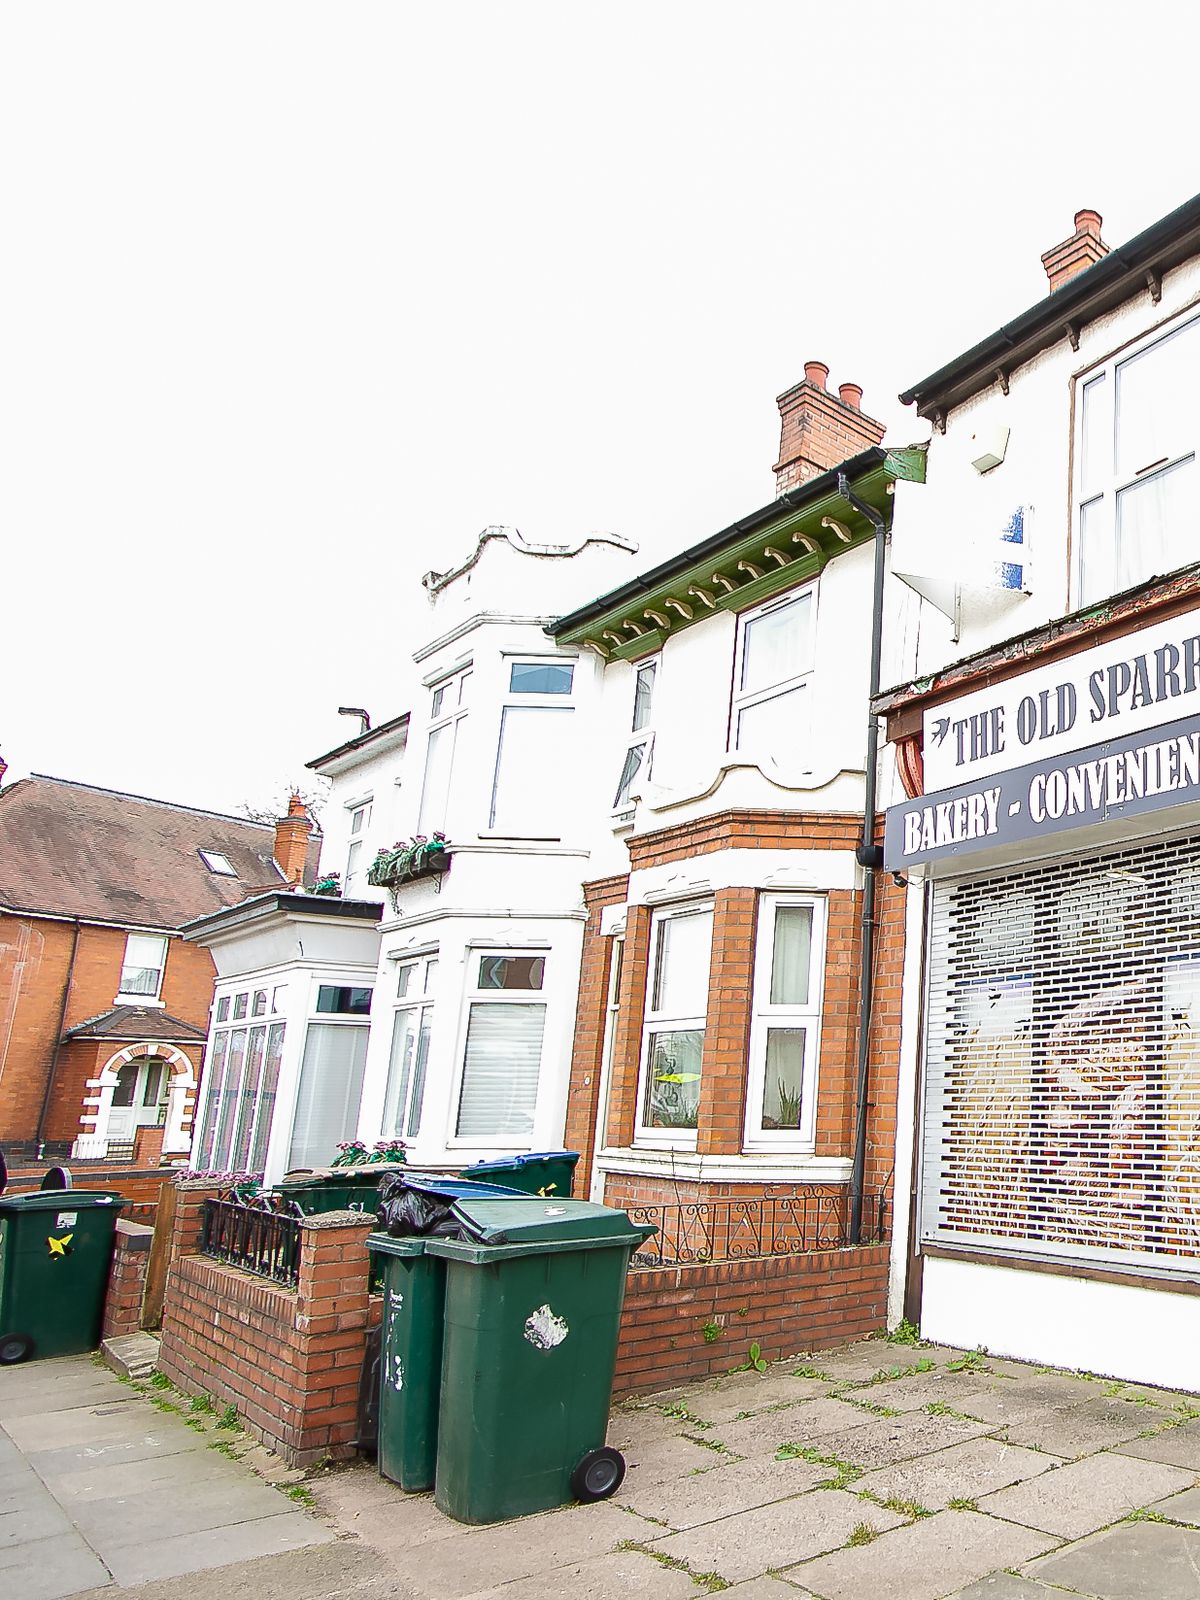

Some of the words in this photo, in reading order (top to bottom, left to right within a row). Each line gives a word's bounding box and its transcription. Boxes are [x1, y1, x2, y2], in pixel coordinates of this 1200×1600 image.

[953, 704, 1006, 766] THE
[1016, 681, 1077, 746] OLD
[902, 785, 1003, 857] BAKERY
